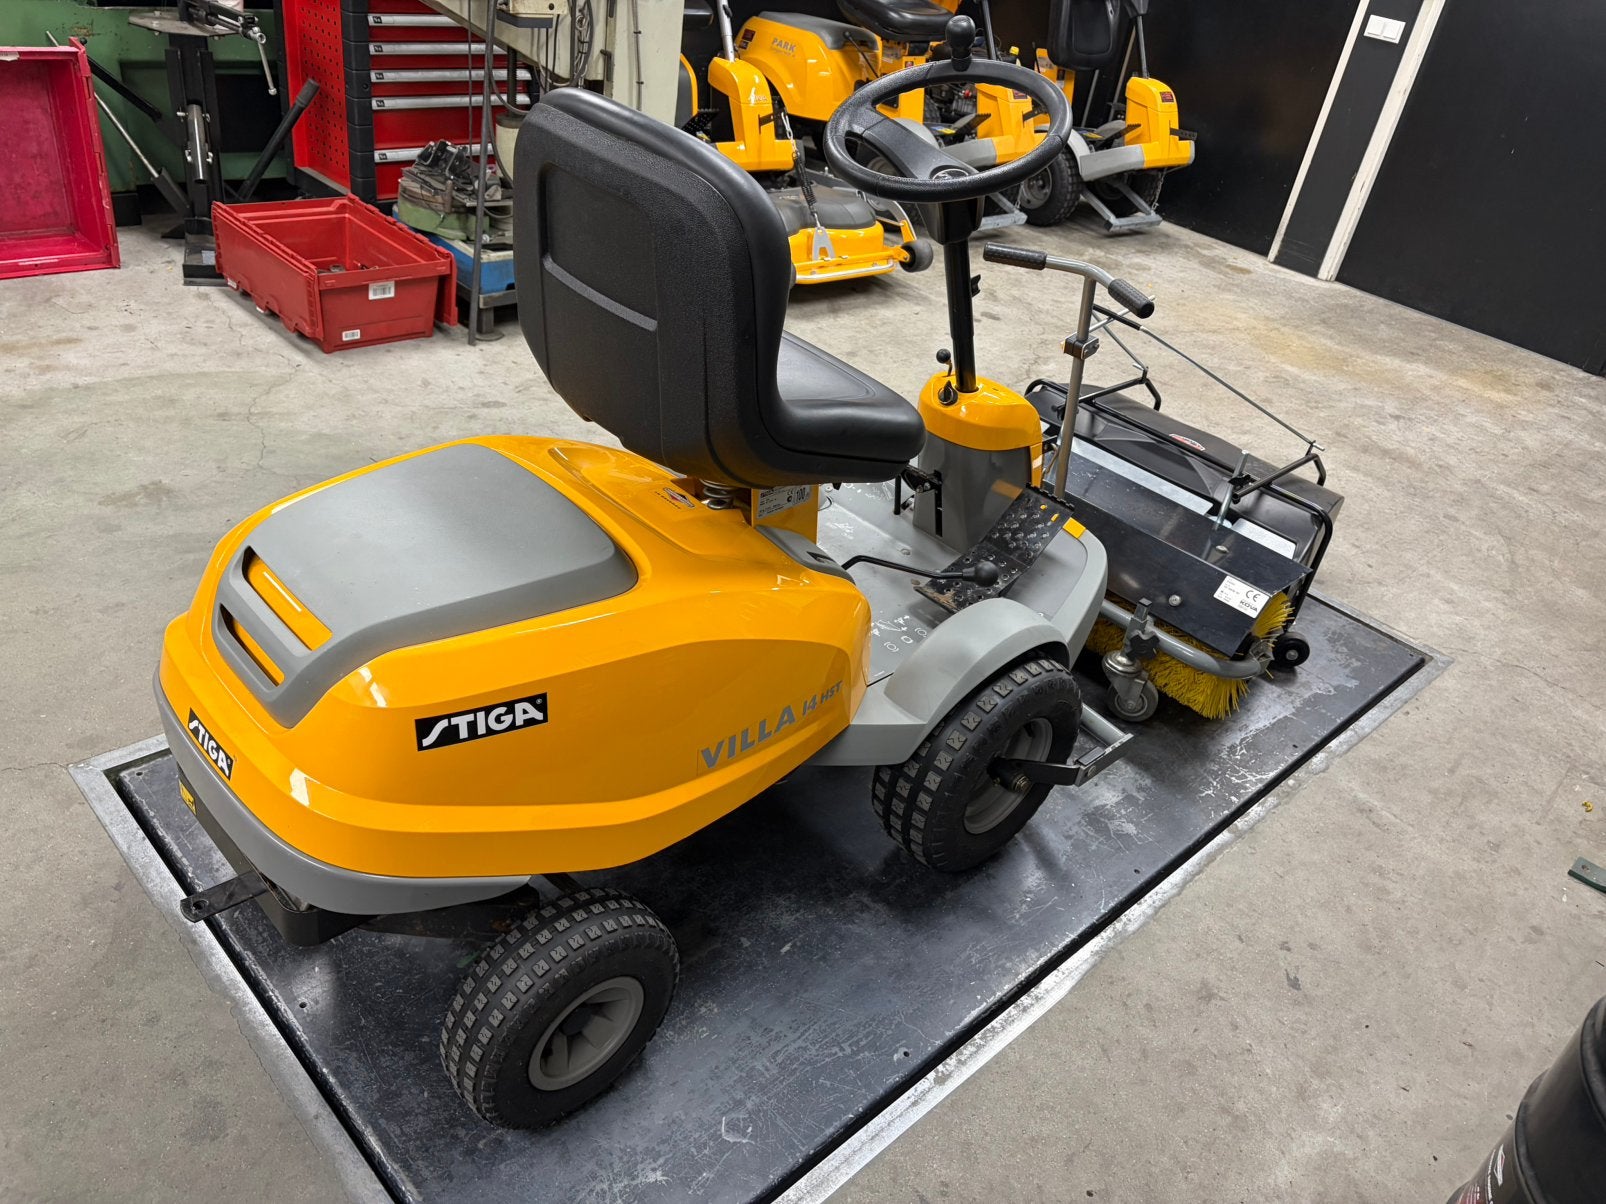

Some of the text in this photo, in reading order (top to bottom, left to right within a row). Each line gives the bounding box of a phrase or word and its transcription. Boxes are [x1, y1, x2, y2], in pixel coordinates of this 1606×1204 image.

[771, 37, 796, 52] PARK
[1246, 590, 1261, 602] CE
[1240, 600, 1258, 612] KOVA
[421, 701, 544, 747] STIGA
[701, 680, 843, 769] VILLA 14 HST
